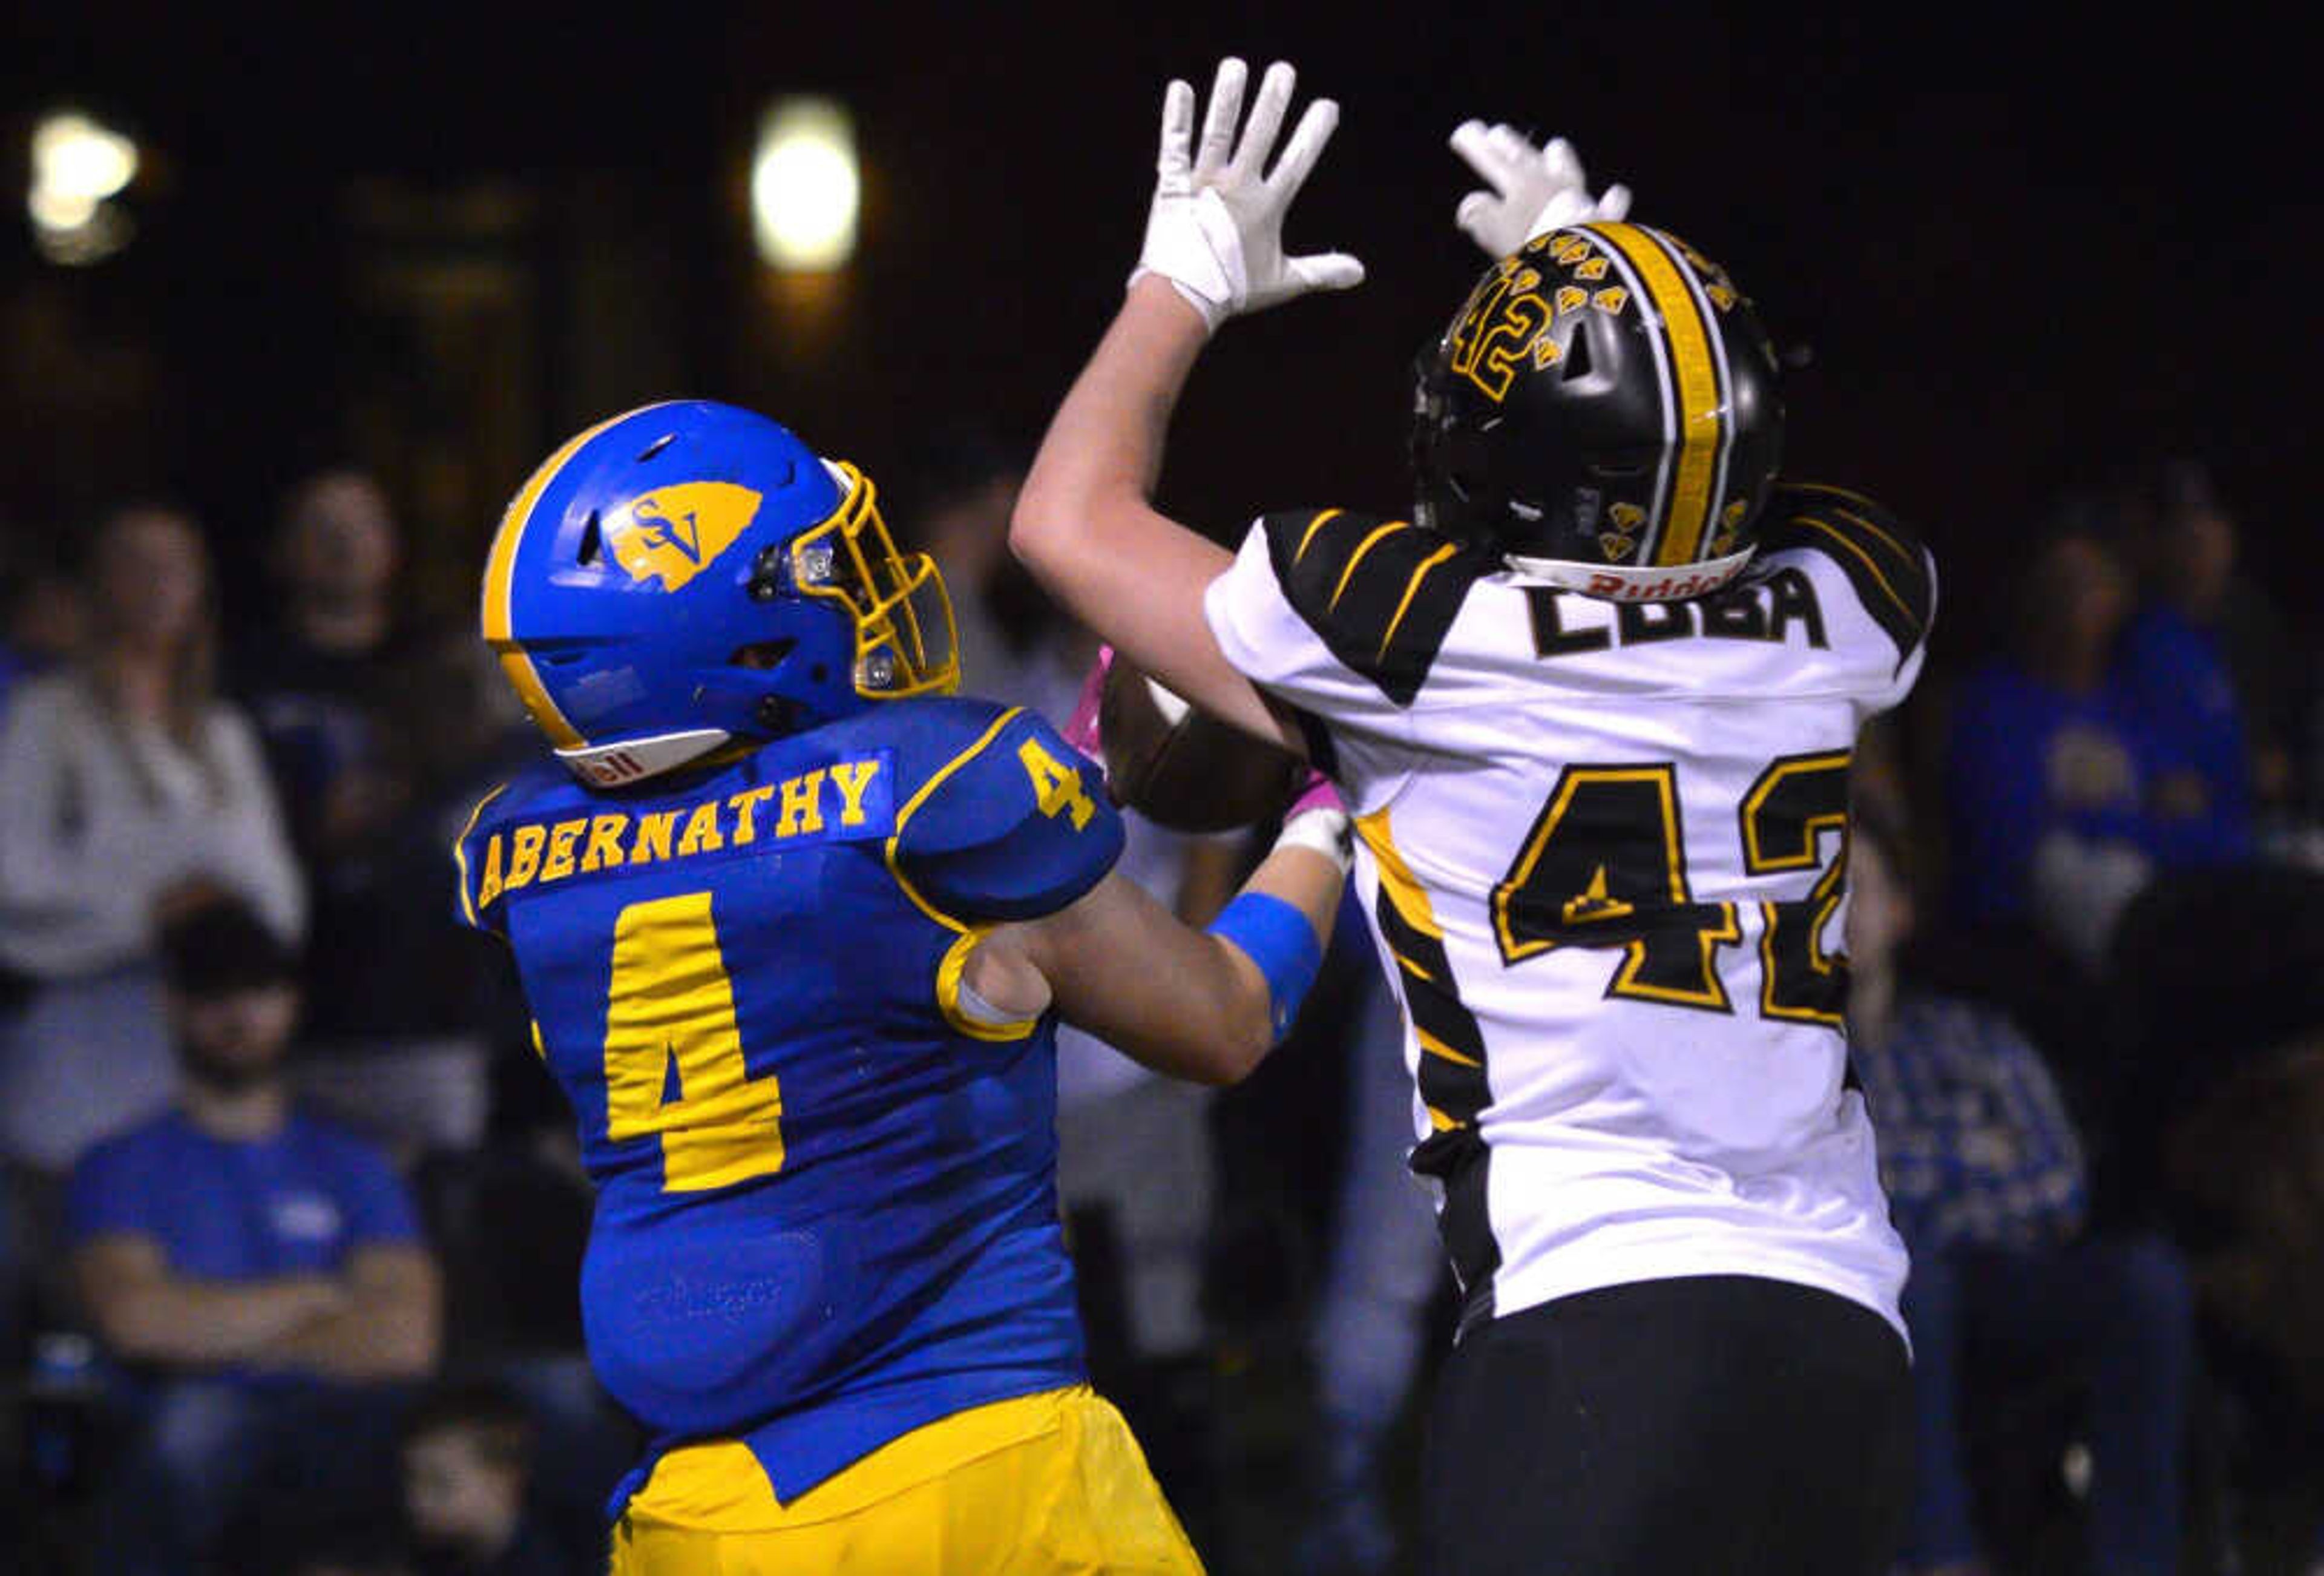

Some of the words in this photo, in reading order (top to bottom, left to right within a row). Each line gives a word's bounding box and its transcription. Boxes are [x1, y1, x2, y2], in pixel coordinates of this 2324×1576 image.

[478, 761, 879, 909] ABERNATHY
[1018, 737, 1096, 832] 4
[1489, 748, 1852, 1028] 42
[605, 891, 786, 1193] 4
